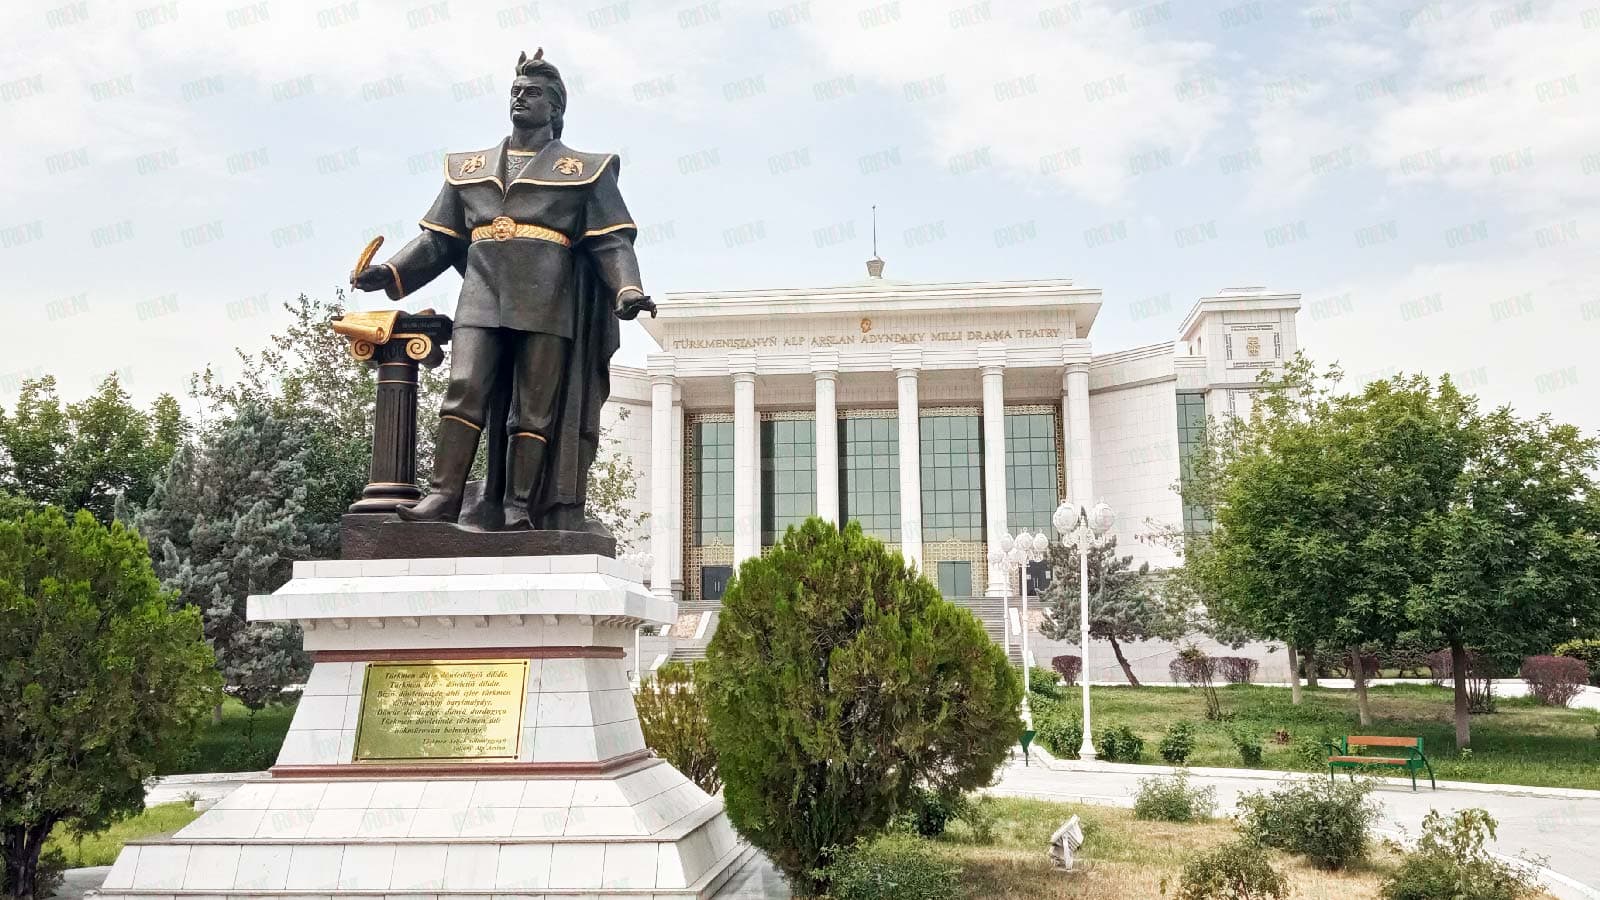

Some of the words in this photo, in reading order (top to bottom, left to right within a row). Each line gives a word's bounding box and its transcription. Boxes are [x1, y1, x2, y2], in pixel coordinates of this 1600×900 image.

[783, 335, 804, 346] ALP
[811, 335, 855, 347] ARSLAN
[967, 330, 1012, 341] DRAMA
[1017, 328, 1060, 338] TEATRY
